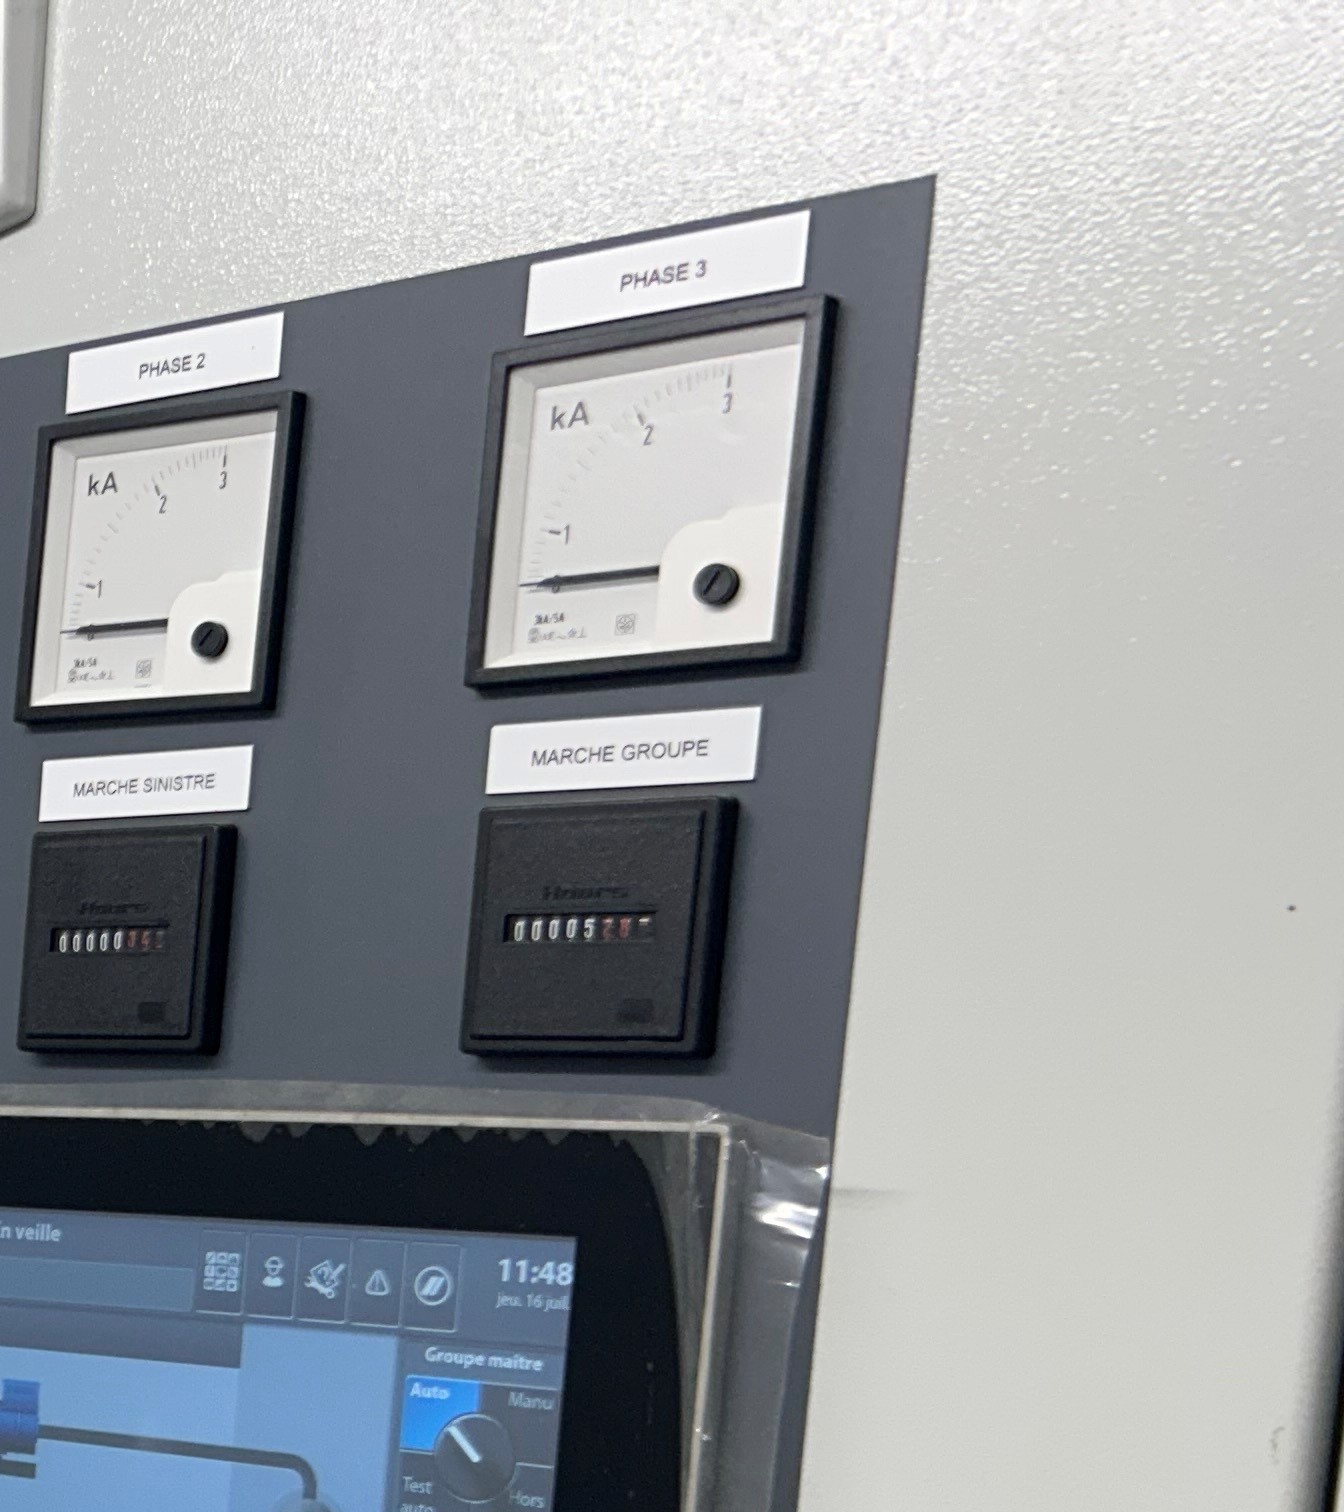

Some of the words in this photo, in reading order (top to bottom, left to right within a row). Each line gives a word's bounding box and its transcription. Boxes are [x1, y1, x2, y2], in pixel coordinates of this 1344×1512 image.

[619, 263, 689, 292] PHASE
[695, 259, 707, 279] 3
[138, 355, 192, 380] PHASE
[196, 352, 206, 371] 2
[722, 391, 733, 414] 3
[549, 400, 590, 432] kA
[642, 422, 654, 446] 2
[87, 470, 119, 497] kA
[219, 470, 228, 490] 3
[158, 495, 168, 514] 2
[563, 523, 571, 545] 1
[97, 579, 103, 599] 1
[530, 745, 616, 767] MARCHE
[621, 739, 710, 762] GROUPE
[72, 778, 139, 798] MARCHE
[142, 773, 217, 794] SINISTRE
[14, 1220, 62, 1243] veille
[497, 1256, 574, 1287] 11:48
[525, 1292, 543, 1309] 16
[424, 1345, 484, 1369] Groupe
[487, 1348, 543, 1372] maître
[410, 1382, 451, 1401] Auto
[508, 1390, 554, 1411] Manu
[401, 1476, 433, 1496] Test
[509, 1488, 545, 1510] Hors
